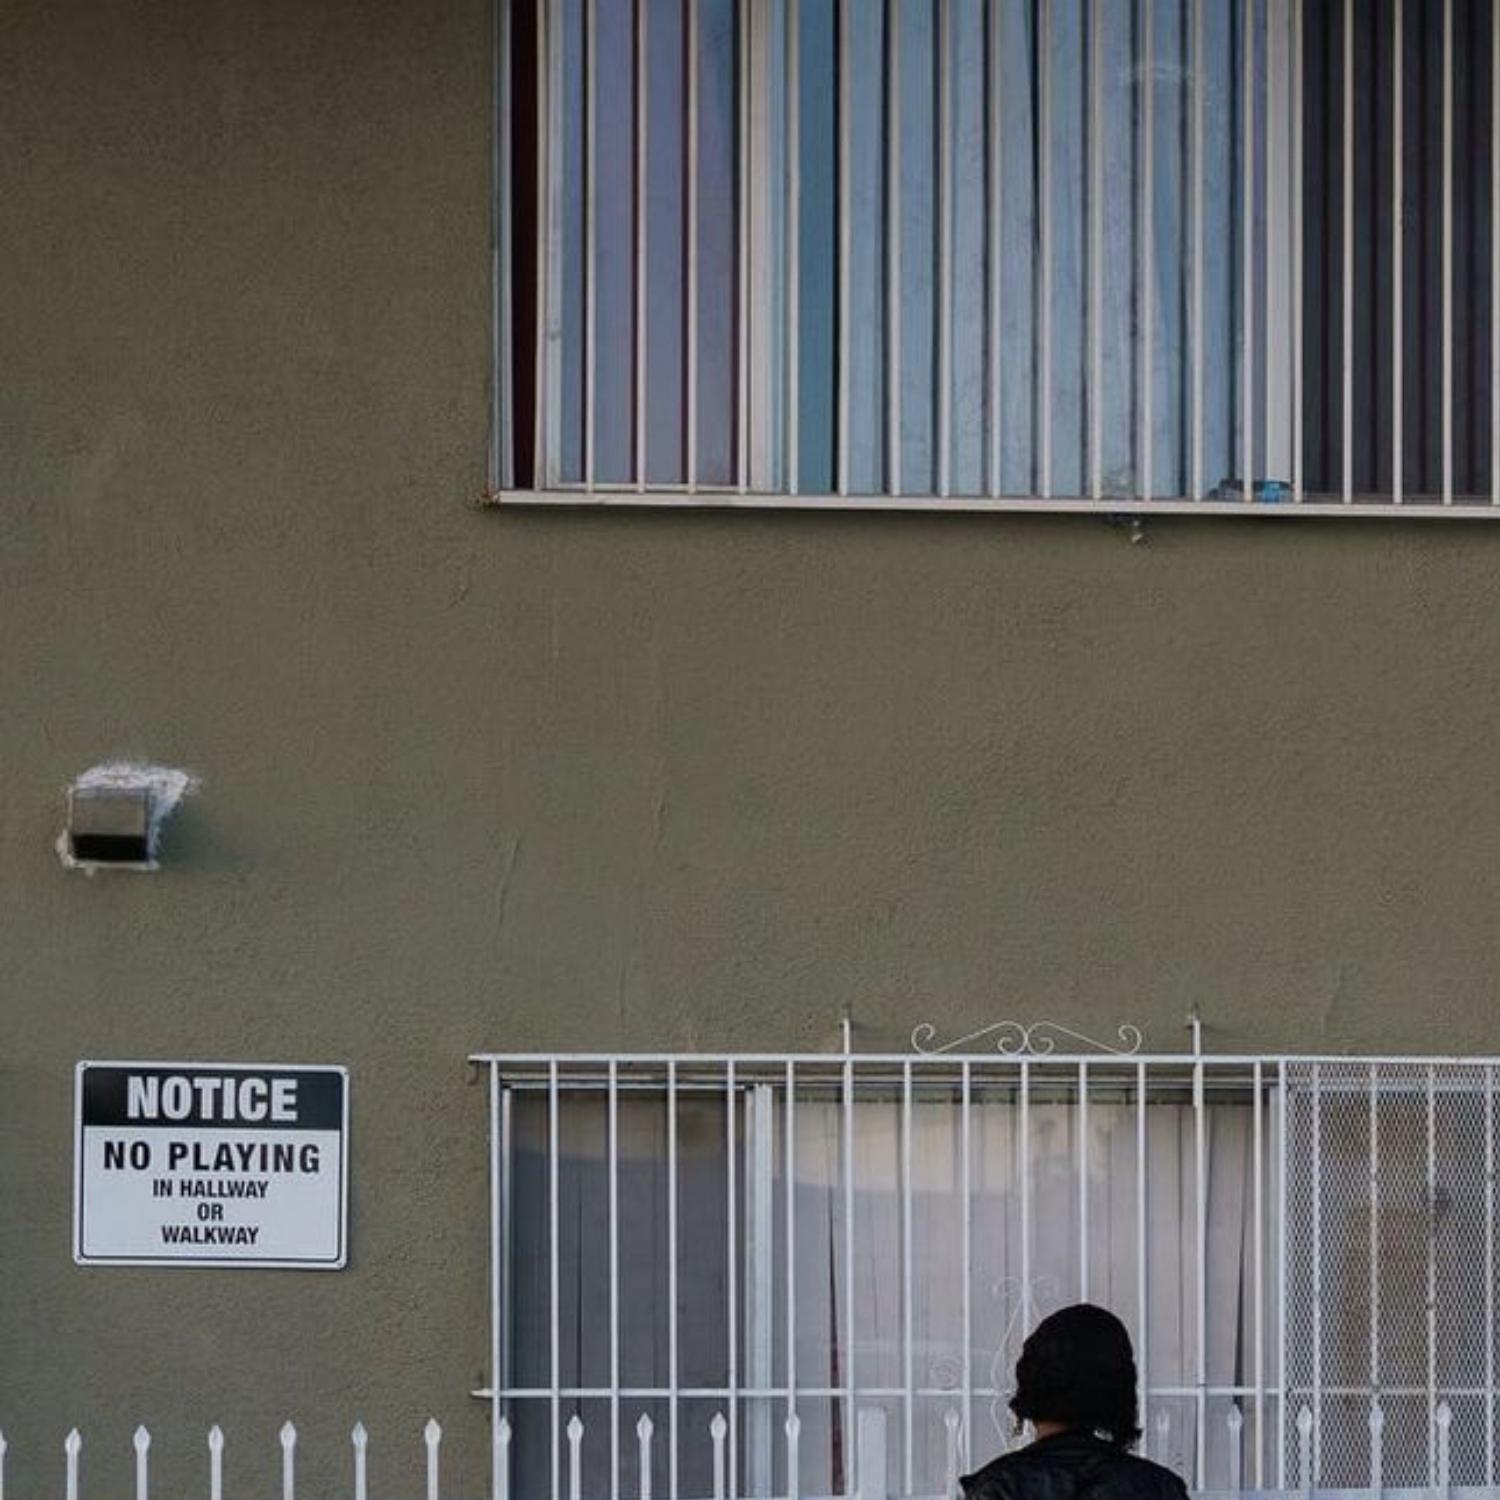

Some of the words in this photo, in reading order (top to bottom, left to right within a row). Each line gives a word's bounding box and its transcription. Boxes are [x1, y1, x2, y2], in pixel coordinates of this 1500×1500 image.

[127, 1076, 298, 1122] NOTICE
[103, 1141, 150, 1170] NO
[168, 1142, 320, 1173] PLAYING
[153, 1179, 172, 1197] IN
[180, 1180, 269, 1199] HALLWAY
[197, 1203, 223, 1221] OR
[162, 1226, 259, 1245] WALKWAY
